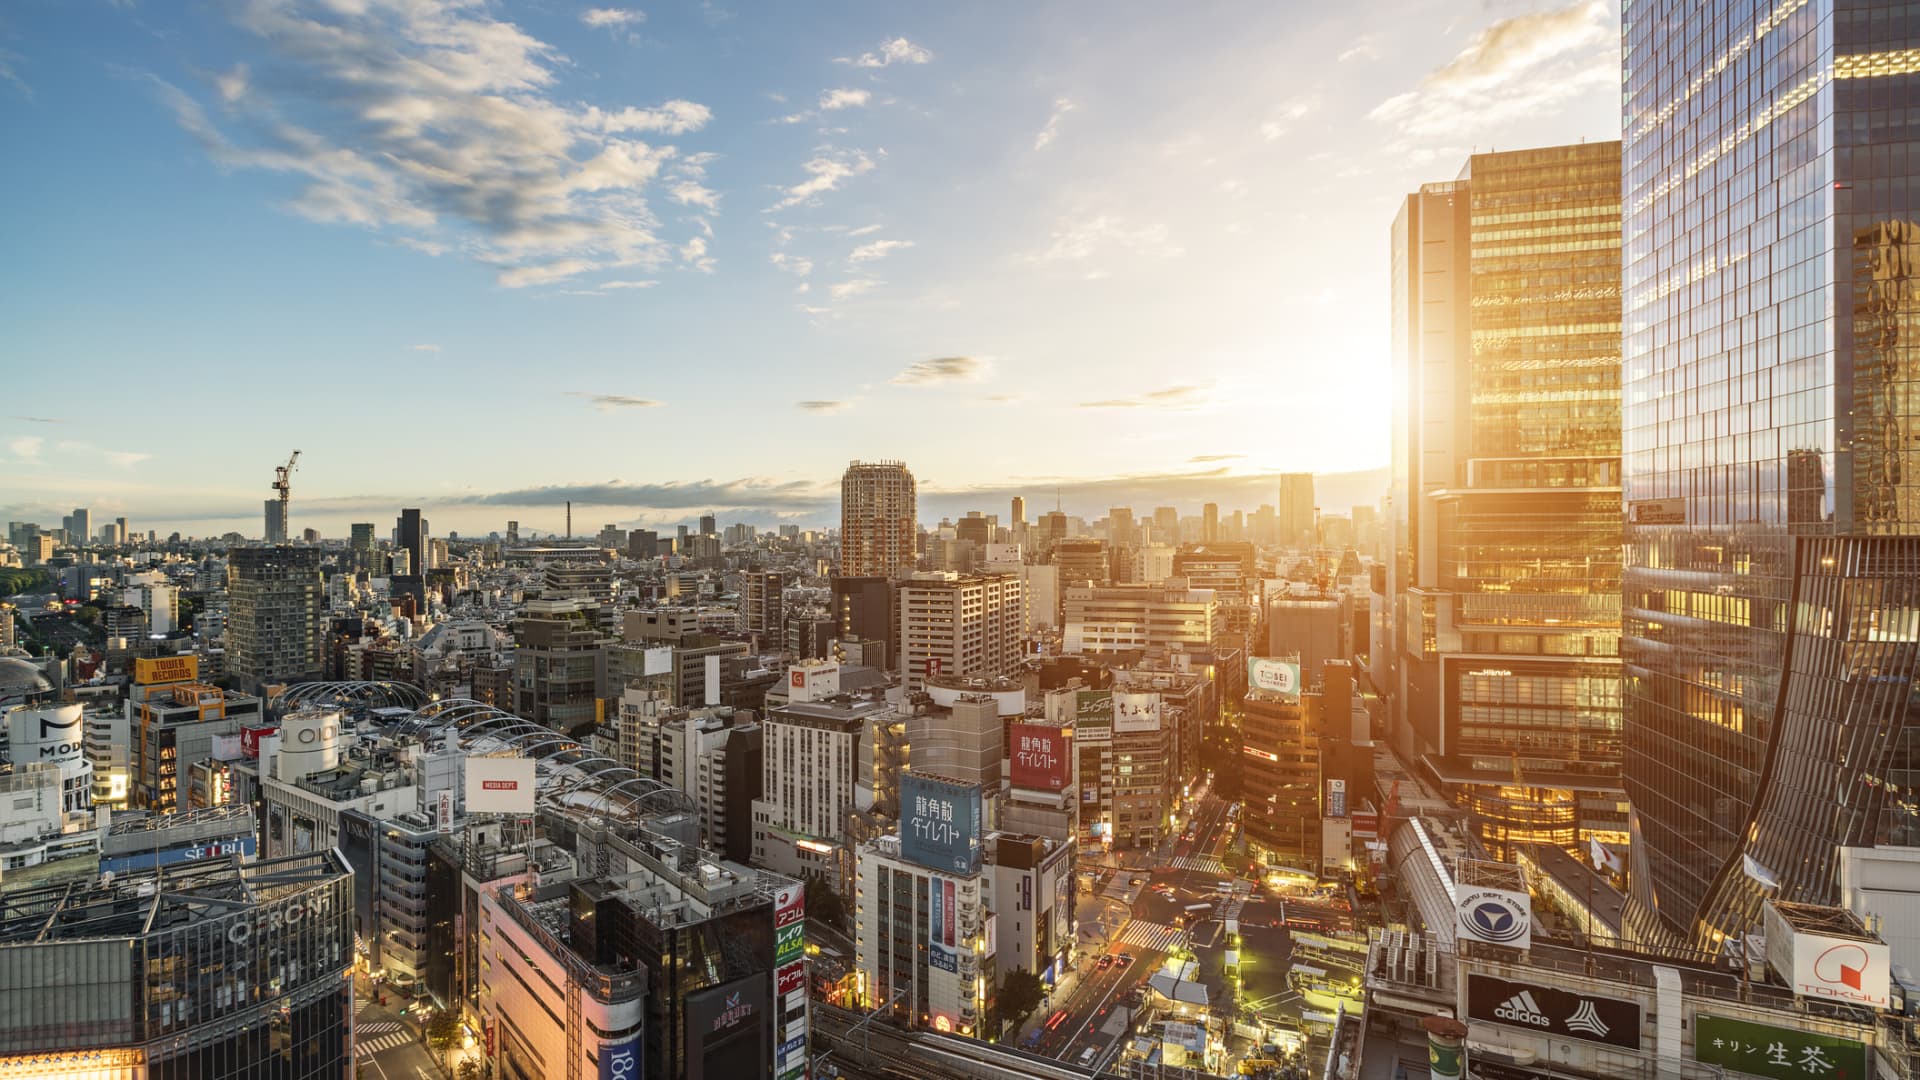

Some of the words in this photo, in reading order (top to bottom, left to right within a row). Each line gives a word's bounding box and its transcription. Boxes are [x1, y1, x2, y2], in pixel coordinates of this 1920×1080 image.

[152, 669, 191, 681] RECORDS
[155, 659, 185, 671] TOWER
[916, 795, 953, 822] 龍角散
[911, 816, 960, 846] ダイレクト
[1461, 892, 1480, 908] TOKYU
[1506, 898, 1527, 917] STORE
[779, 907, 804, 925] アコム
[778, 924, 803, 944] レイク
[777, 936, 803, 956] ALSA
[779, 969, 803, 986] アイフル
[1799, 983, 1885, 1005] TOKYU
[1494, 1007, 1551, 1027] adidas
[1765, 1041, 1835, 1075] 生茶
